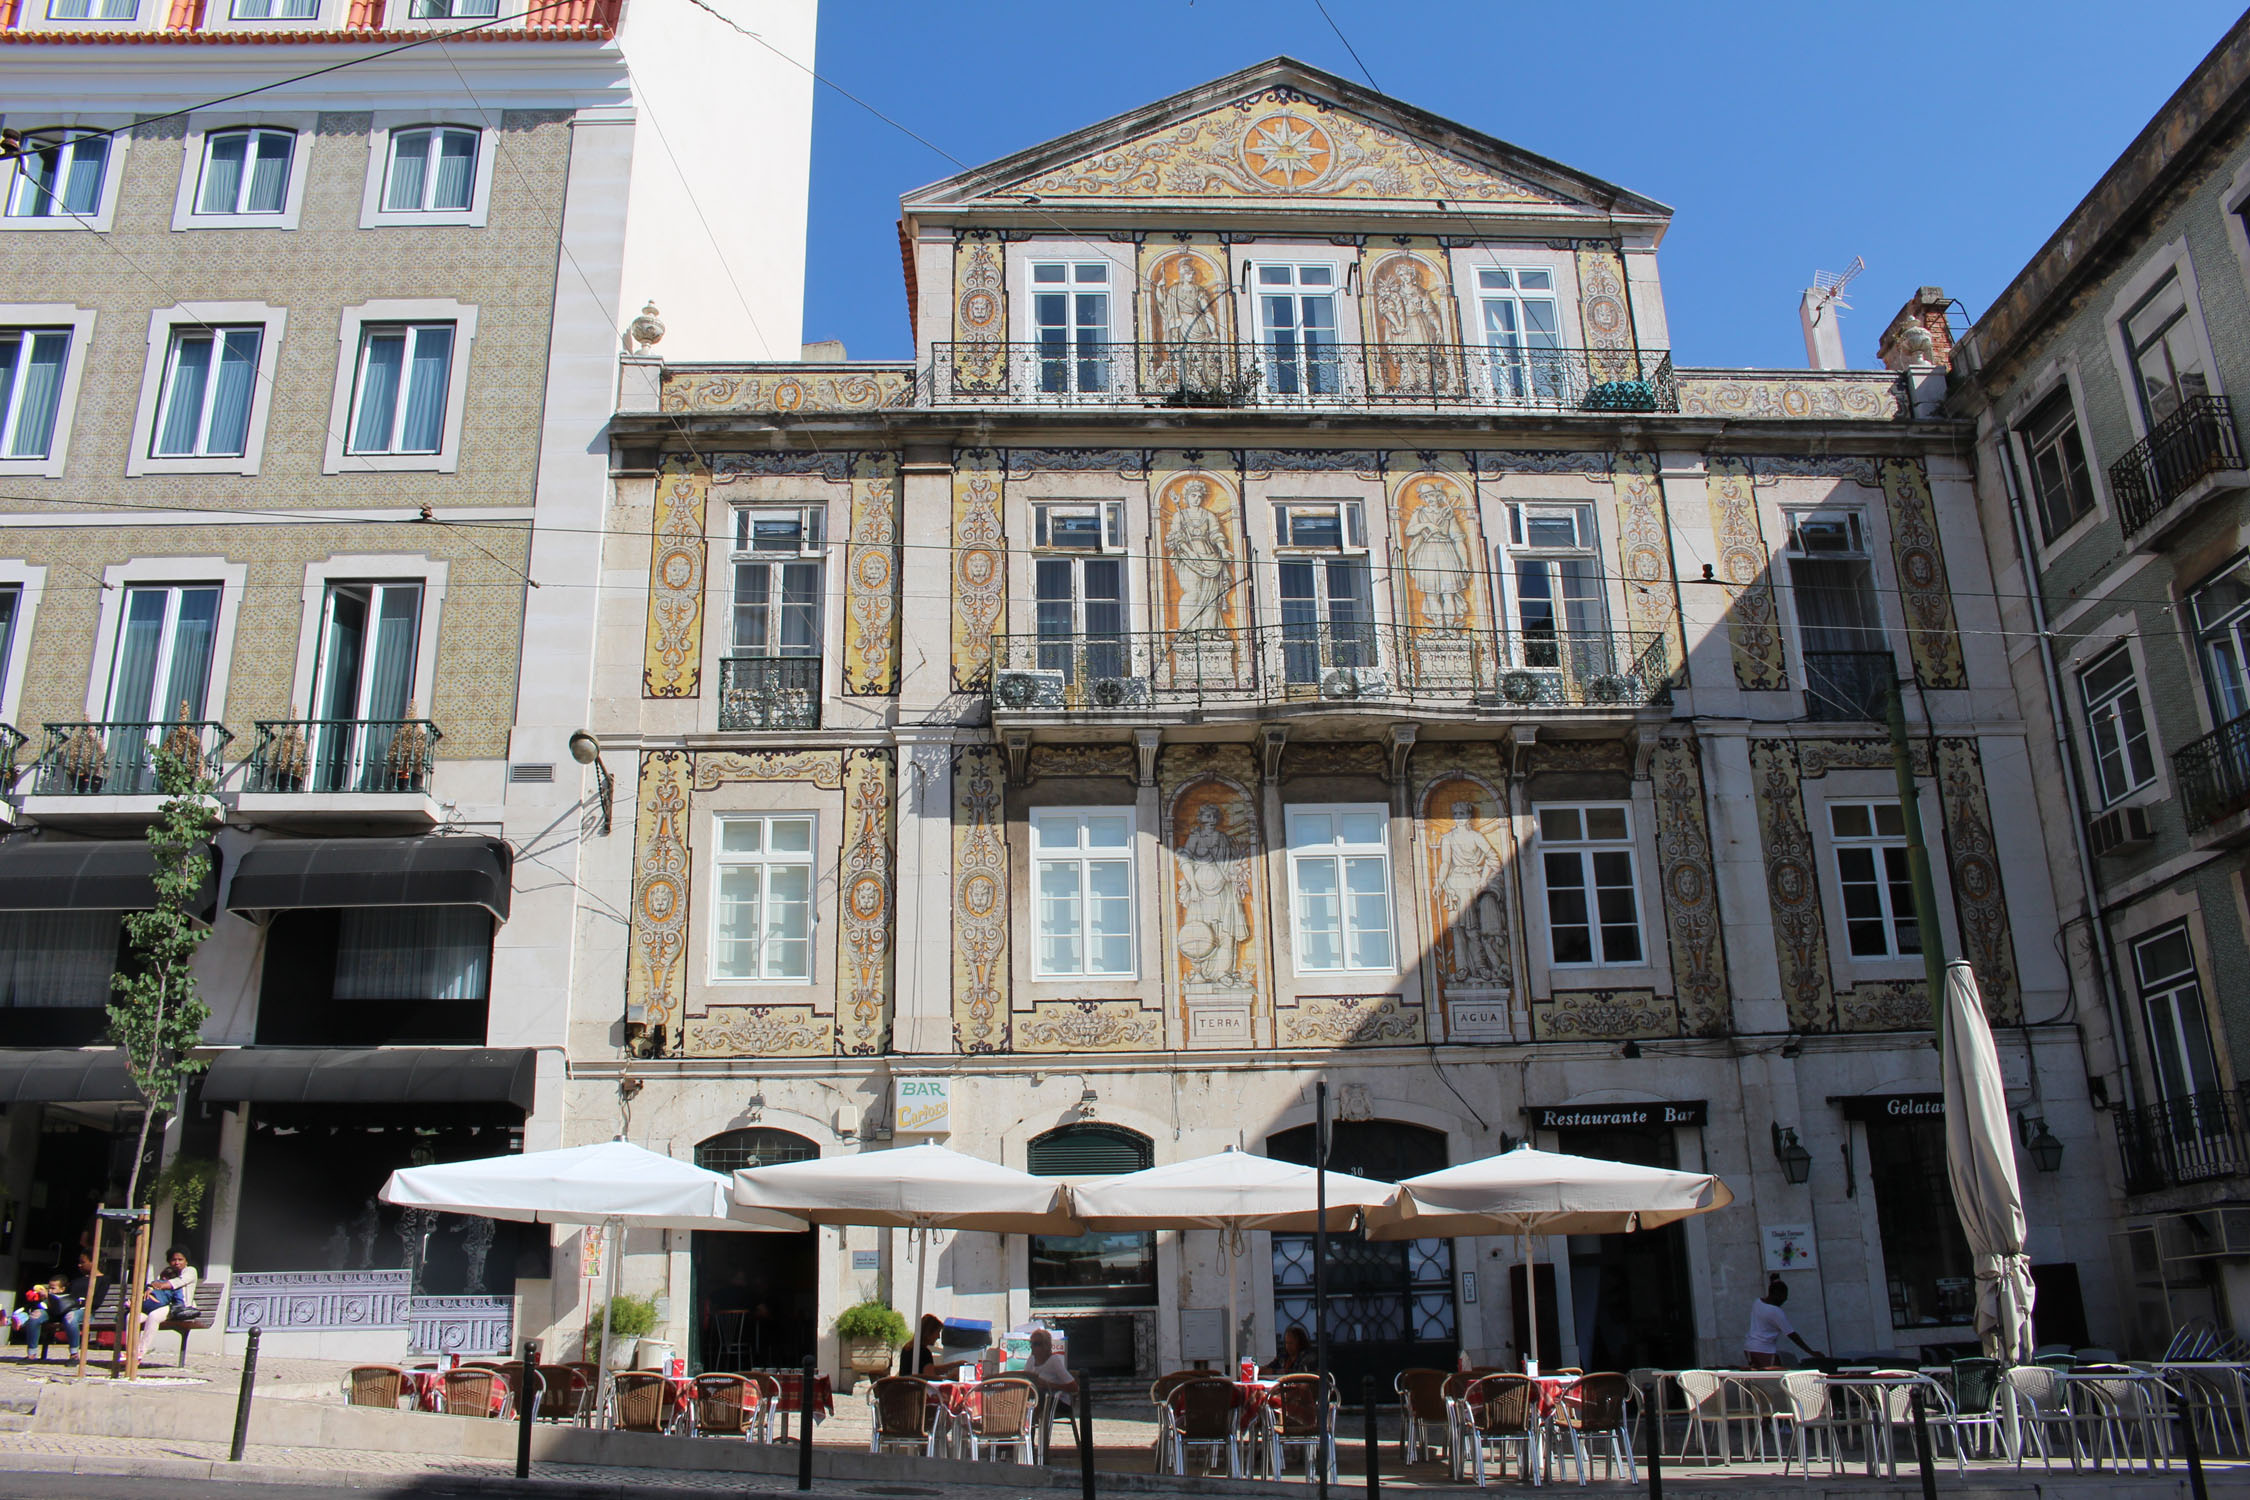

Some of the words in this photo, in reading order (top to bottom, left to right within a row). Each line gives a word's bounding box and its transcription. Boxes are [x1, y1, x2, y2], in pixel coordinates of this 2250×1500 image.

[1200, 1019, 1240, 1028] TERRA
[901, 1082, 946, 1096] BAR
[897, 1101, 948, 1128] Carioca
[1543, 1110, 1648, 1126] Restaurante
[1664, 1107, 1696, 1122] Bar
[1351, 1166, 1363, 1176] 30
